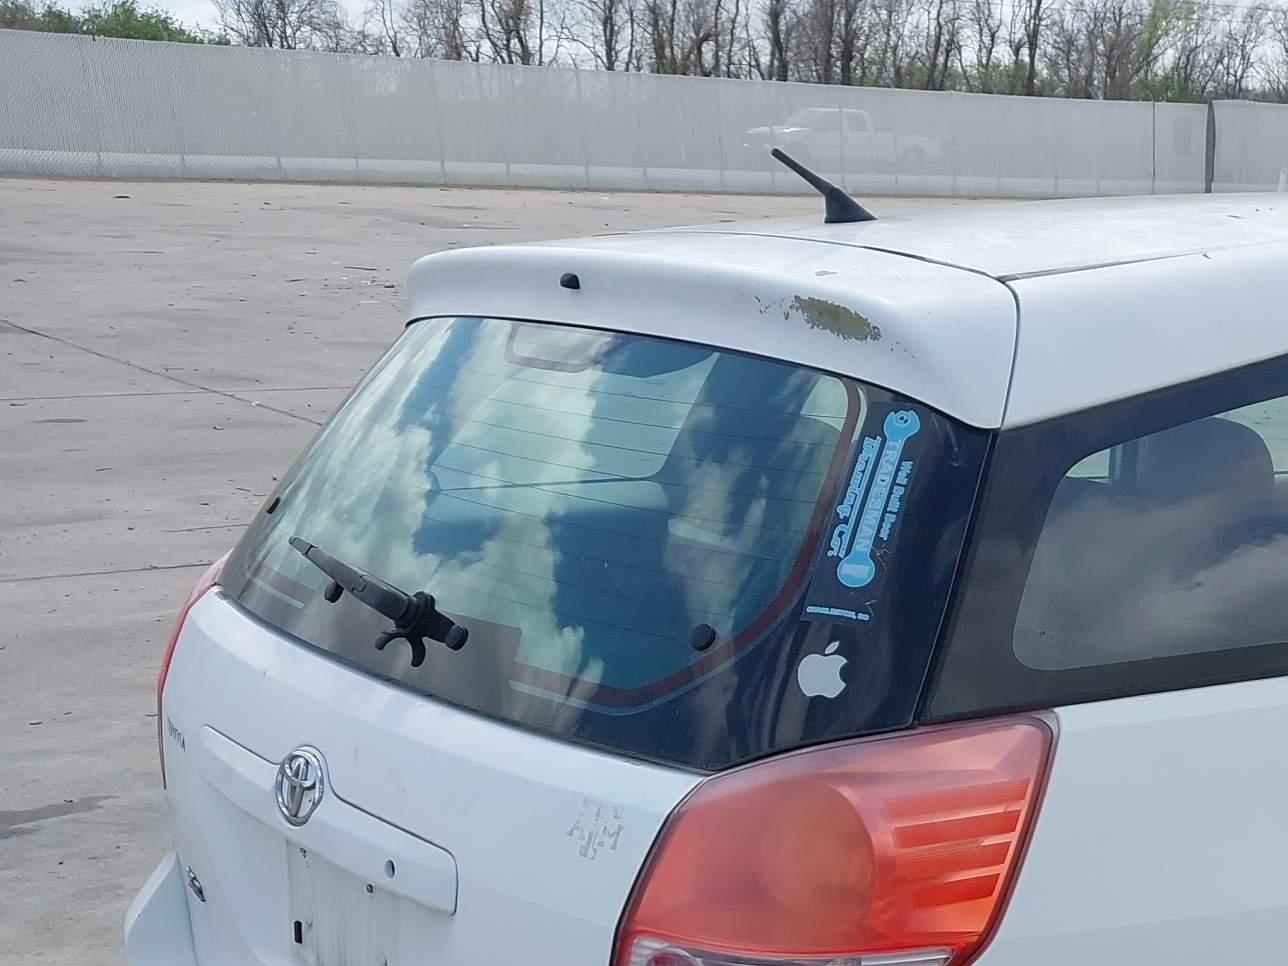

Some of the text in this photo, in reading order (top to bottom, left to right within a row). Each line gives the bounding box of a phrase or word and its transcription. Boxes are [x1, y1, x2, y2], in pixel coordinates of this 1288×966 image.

[836, 436, 880, 519] Brewing
[855, 440, 902, 552] TRADESMAN
[887, 485, 905, 512] Built
[167, 717, 186, 752] TOYOTA
